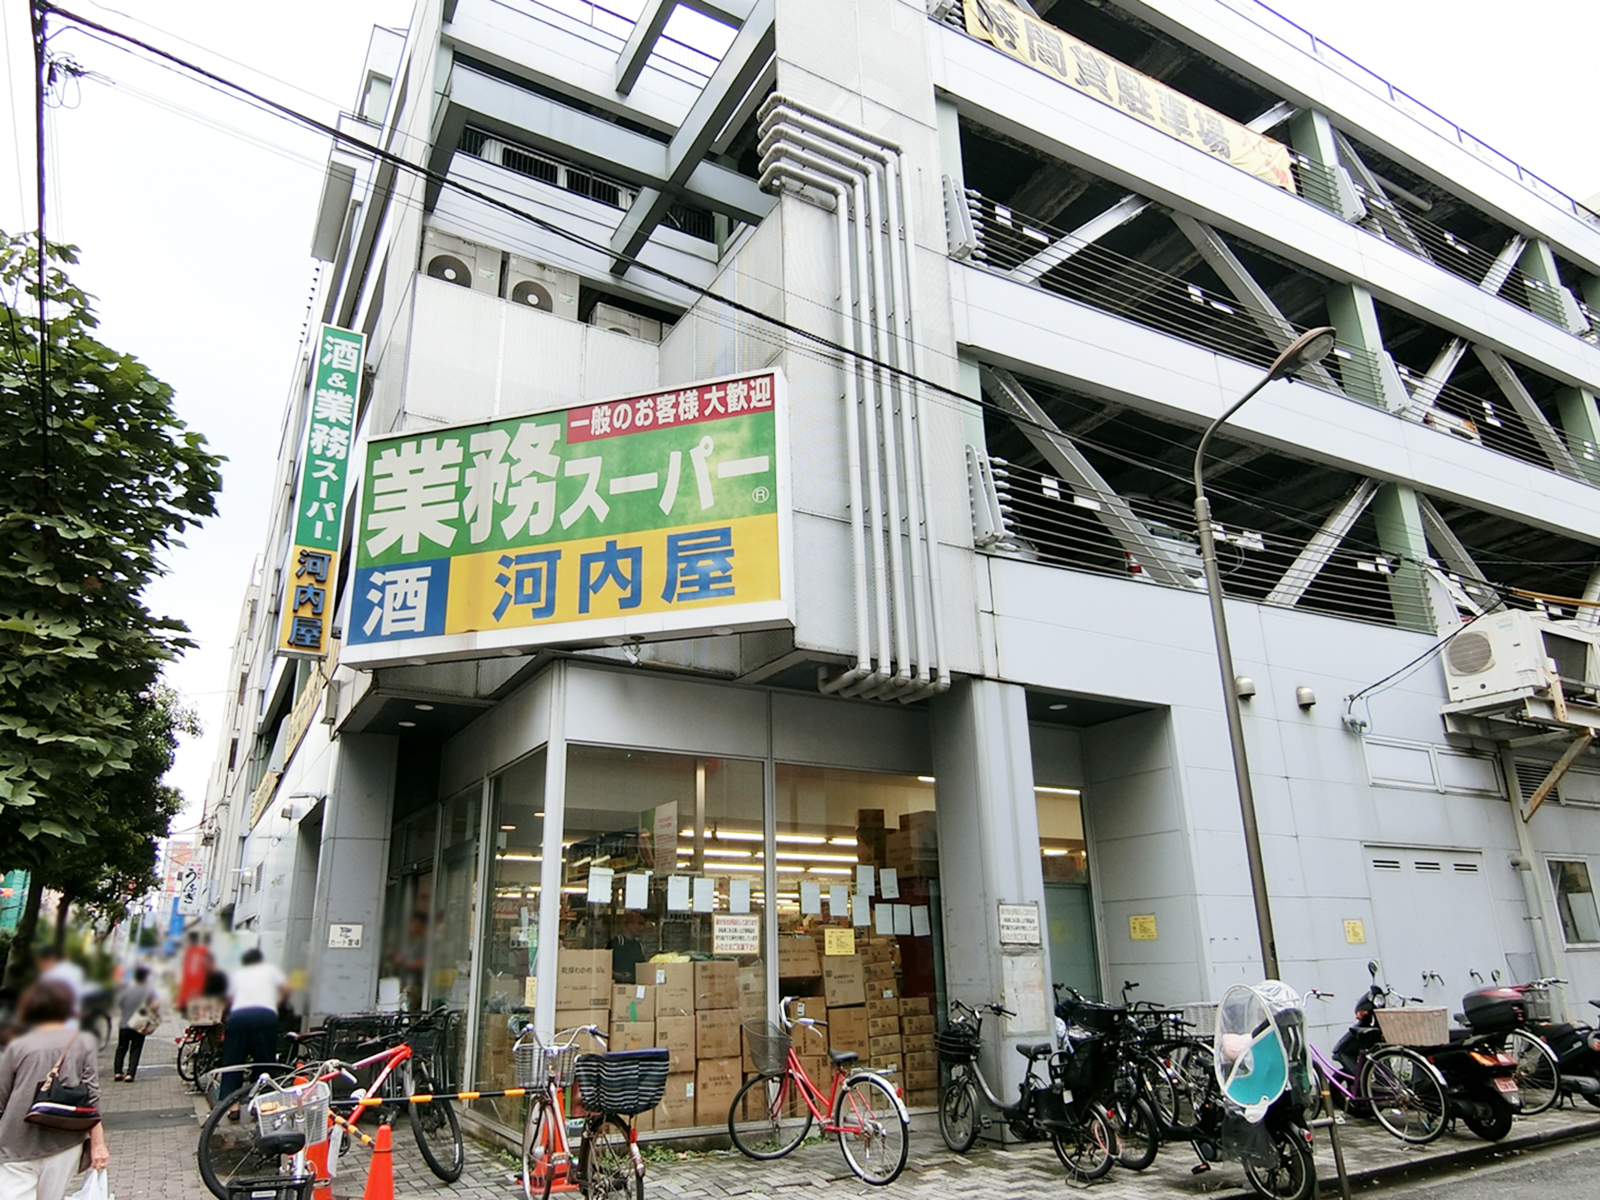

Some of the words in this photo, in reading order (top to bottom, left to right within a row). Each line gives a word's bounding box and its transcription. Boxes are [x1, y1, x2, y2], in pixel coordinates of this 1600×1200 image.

[365, 422, 770, 558] 業務スーパー
[287, 549, 331, 649] 河内屋
[362, 566, 432, 636] 酒
[492, 526, 736, 623] 河内屋
